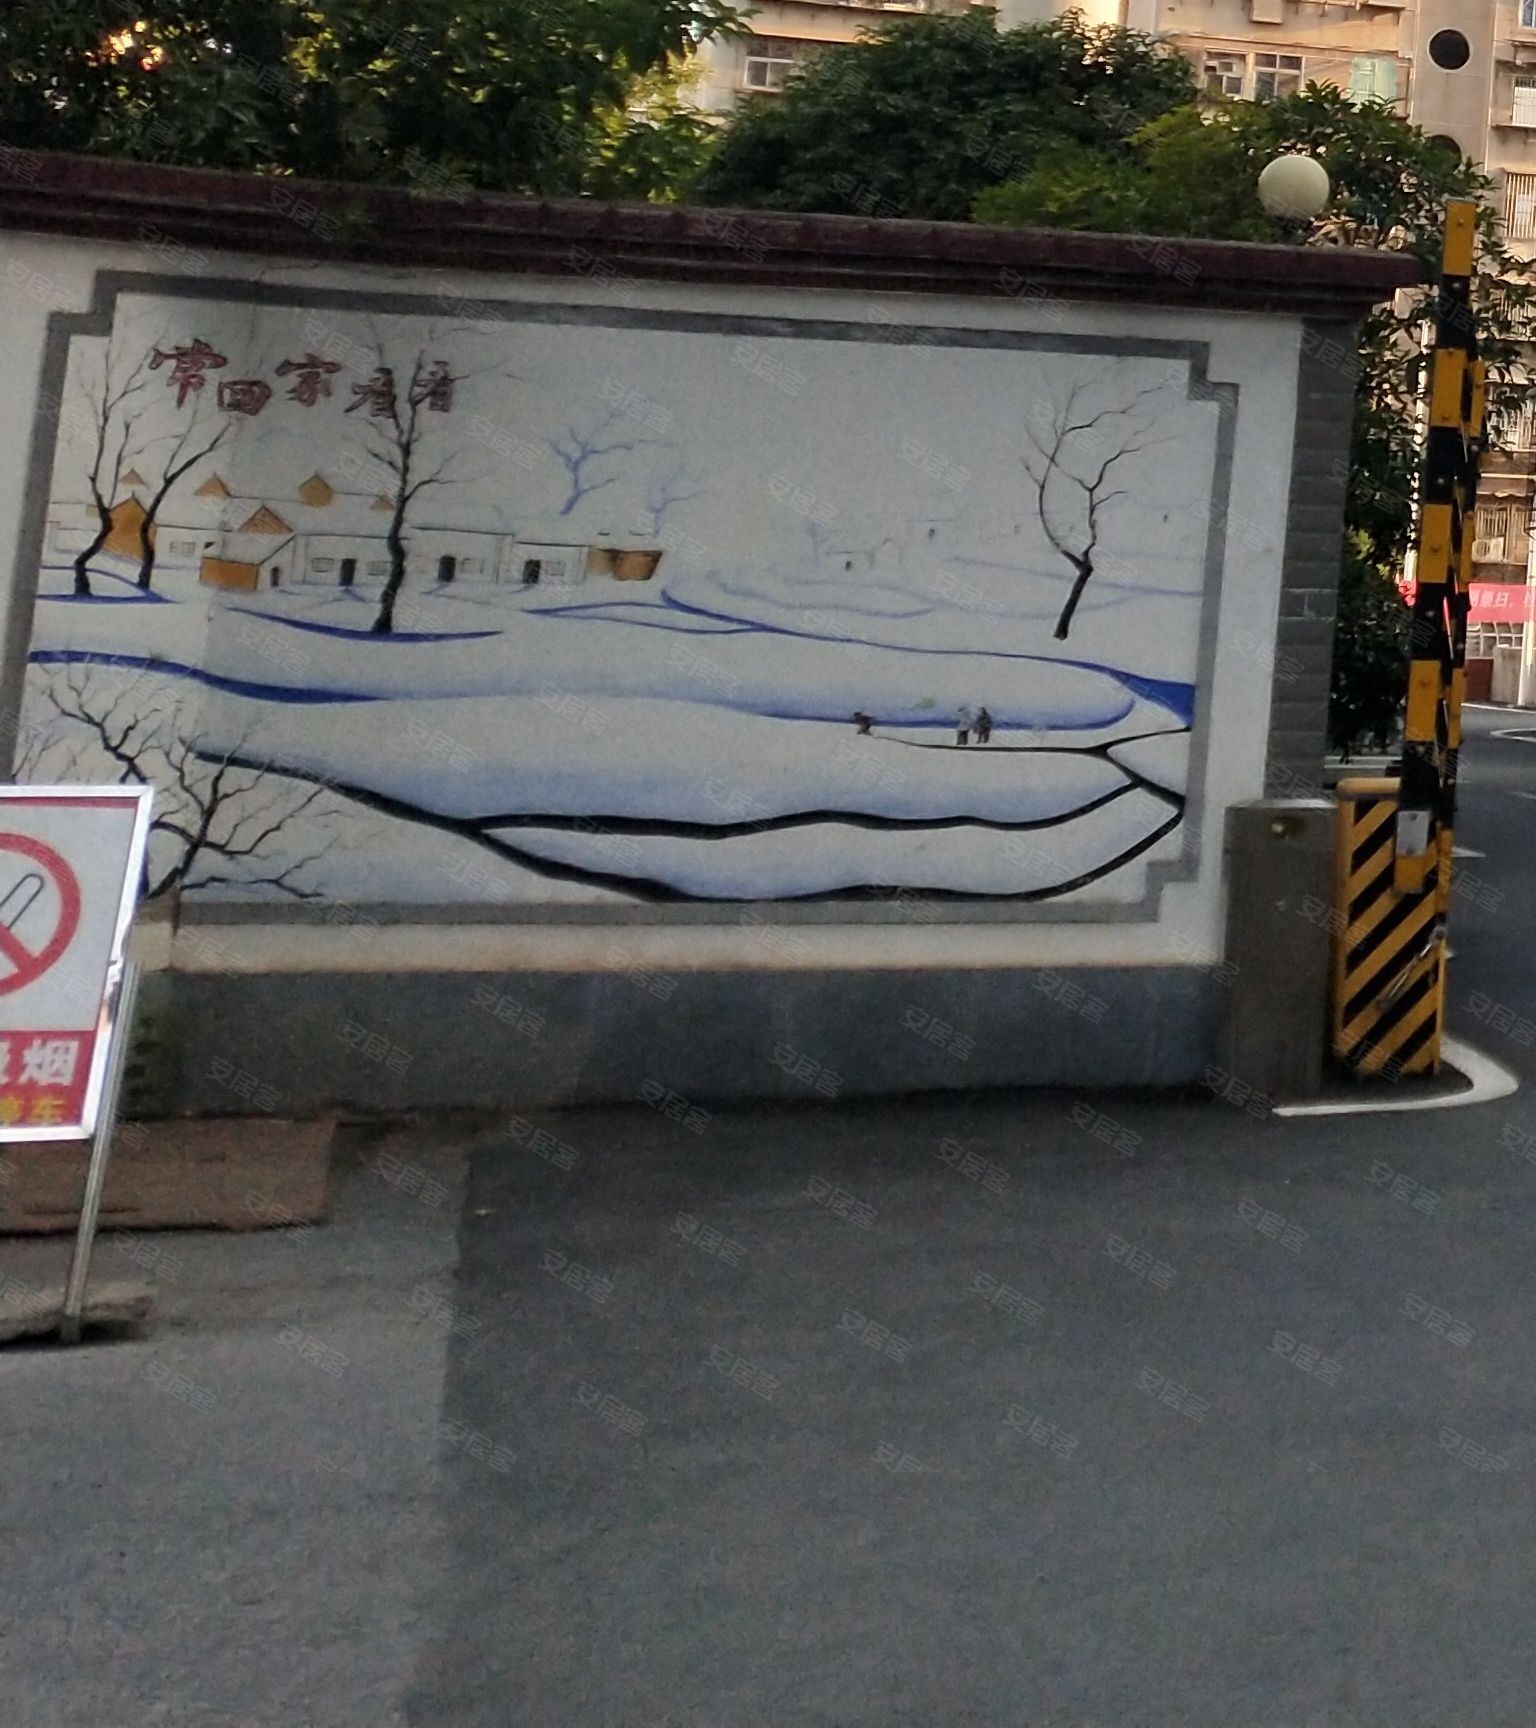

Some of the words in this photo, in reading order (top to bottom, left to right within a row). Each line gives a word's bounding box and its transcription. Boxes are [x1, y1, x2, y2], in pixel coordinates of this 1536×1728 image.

[147, 338, 457, 417] 常回家看看
[0, 1037, 80, 1086] 烟
